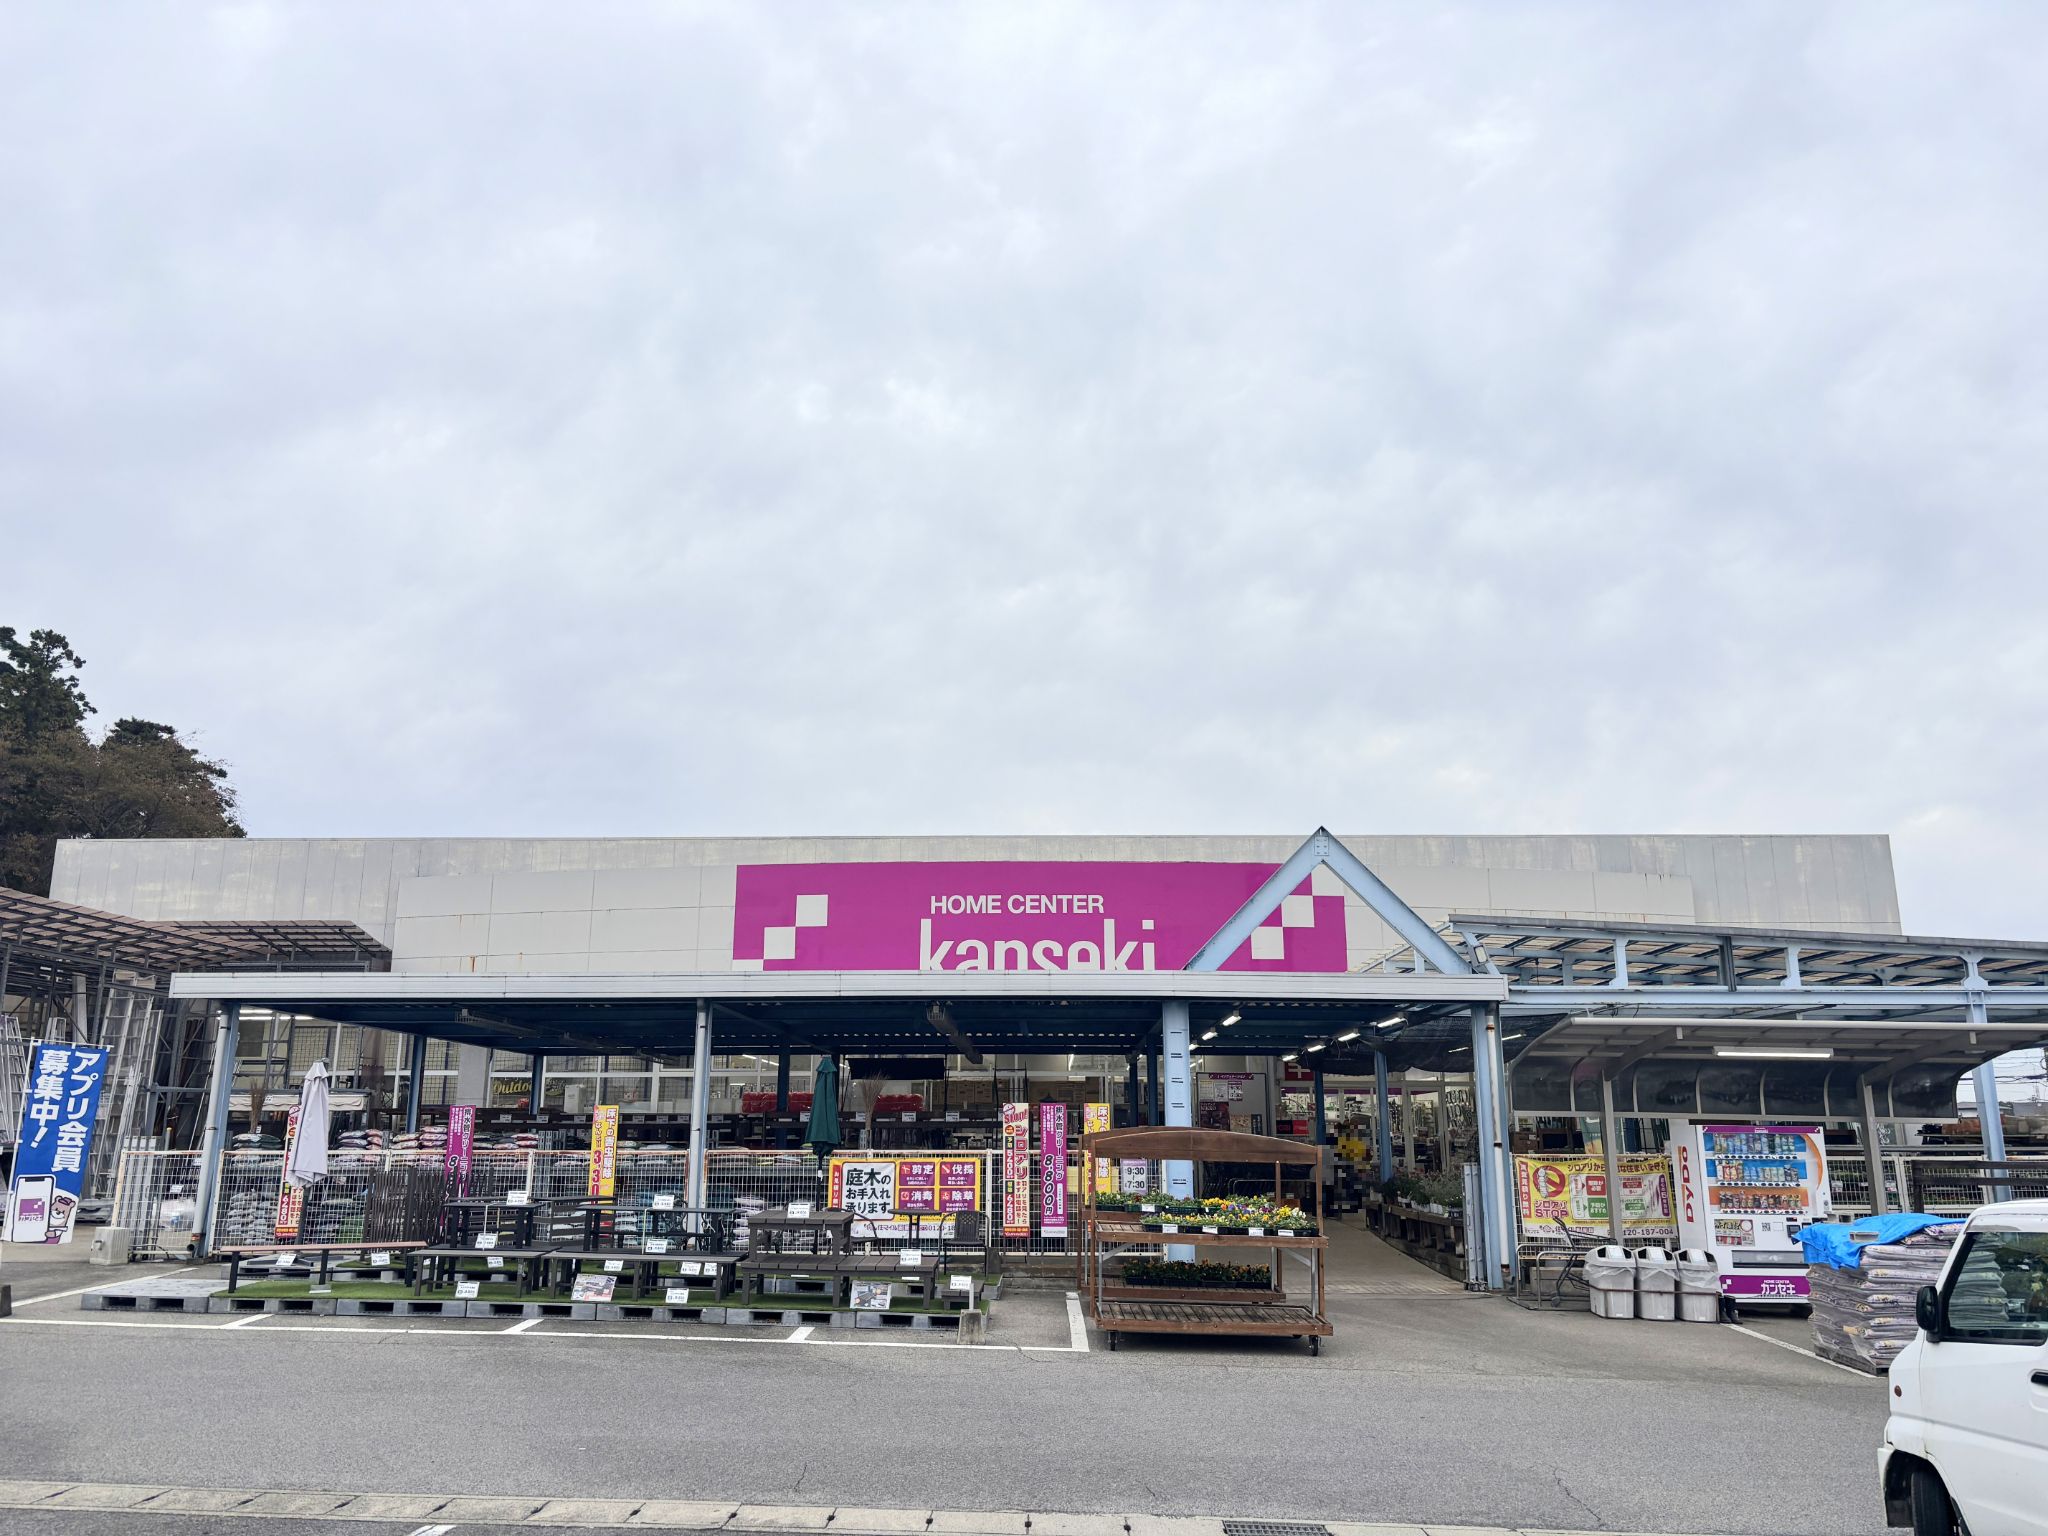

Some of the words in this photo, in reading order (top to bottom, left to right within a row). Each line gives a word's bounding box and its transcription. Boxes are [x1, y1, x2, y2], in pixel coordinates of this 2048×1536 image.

[930, 895, 1002, 914] HOME
[1007, 894, 1105, 914] CENTER
[919, 918, 1156, 971] kanseki
[29, 1049, 71, 1149] 募集中!
[50, 1051, 101, 1174] アプリ会員
[1015, 1125, 1028, 1180] シロアリ
[911, 1164, 934, 1175] 剪定
[951, 1164, 974, 1175] 伐採
[1127, 1167, 1145, 1175] 9:30
[845, 1167, 891, 1186] 庭木の
[1127, 1180, 1145, 1189] 7:30
[845, 1188, 891, 1200] お手入れ
[911, 1190, 933, 1201] 消毒
[951, 1190, 974, 1201] 除草
[845, 1201, 891, 1214] 承ります
[1535, 1200, 1567, 1209] シロアリ
[1535, 1209, 1569, 1217] STOP
[1623, 1228, 1674, 1236] 120-187-004
[1760, 1283, 1796, 1295] カンセキ
